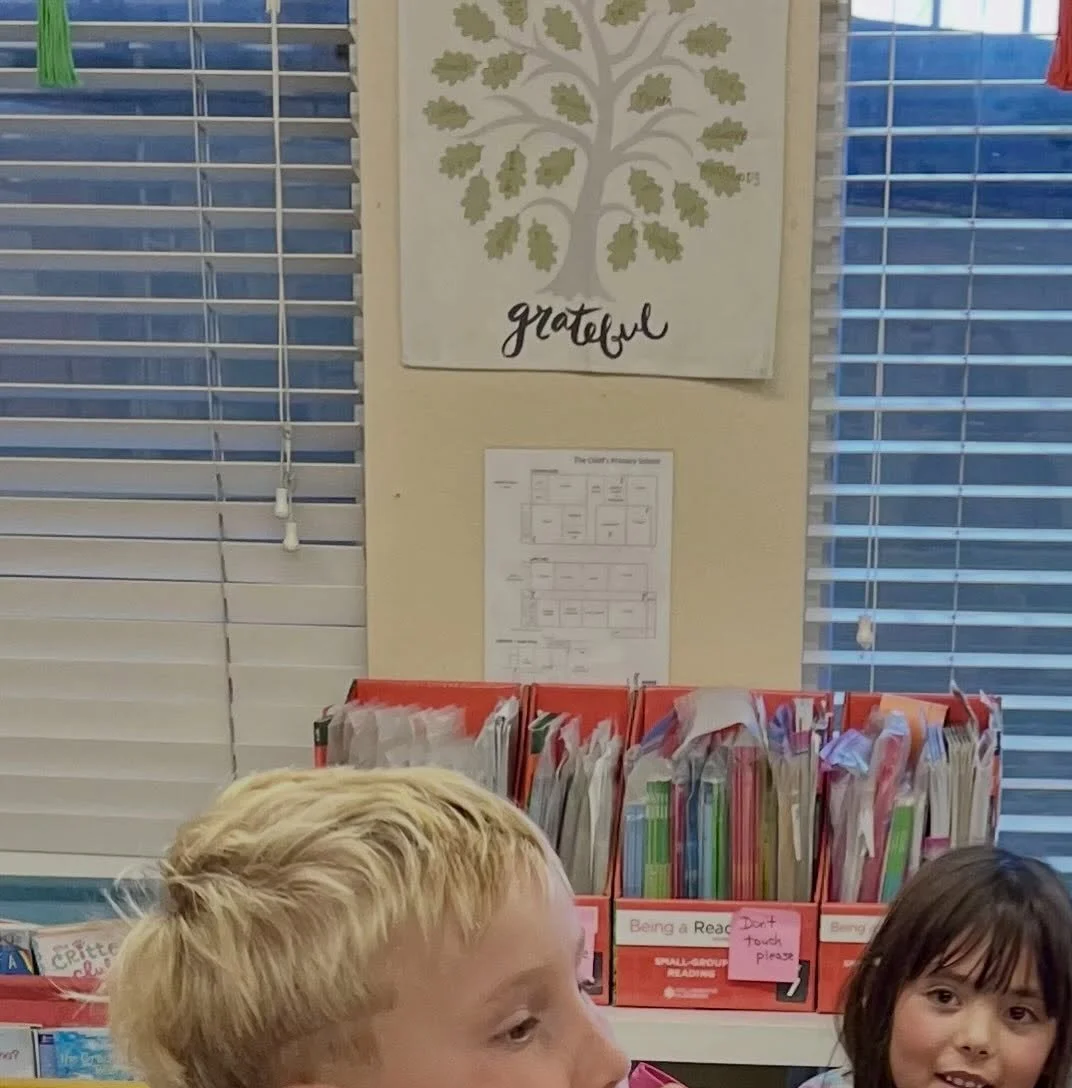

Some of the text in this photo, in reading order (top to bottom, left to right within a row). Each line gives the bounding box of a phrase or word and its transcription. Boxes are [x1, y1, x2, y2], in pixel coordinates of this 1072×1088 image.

[502, 302, 668, 359] grateful
[630, 920, 729, 935] Being a Rea
[831, 922, 867, 935] Being
[743, 933, 783, 947] touch
[756, 950, 794, 964] please
[667, 968, 716, 979] READING
